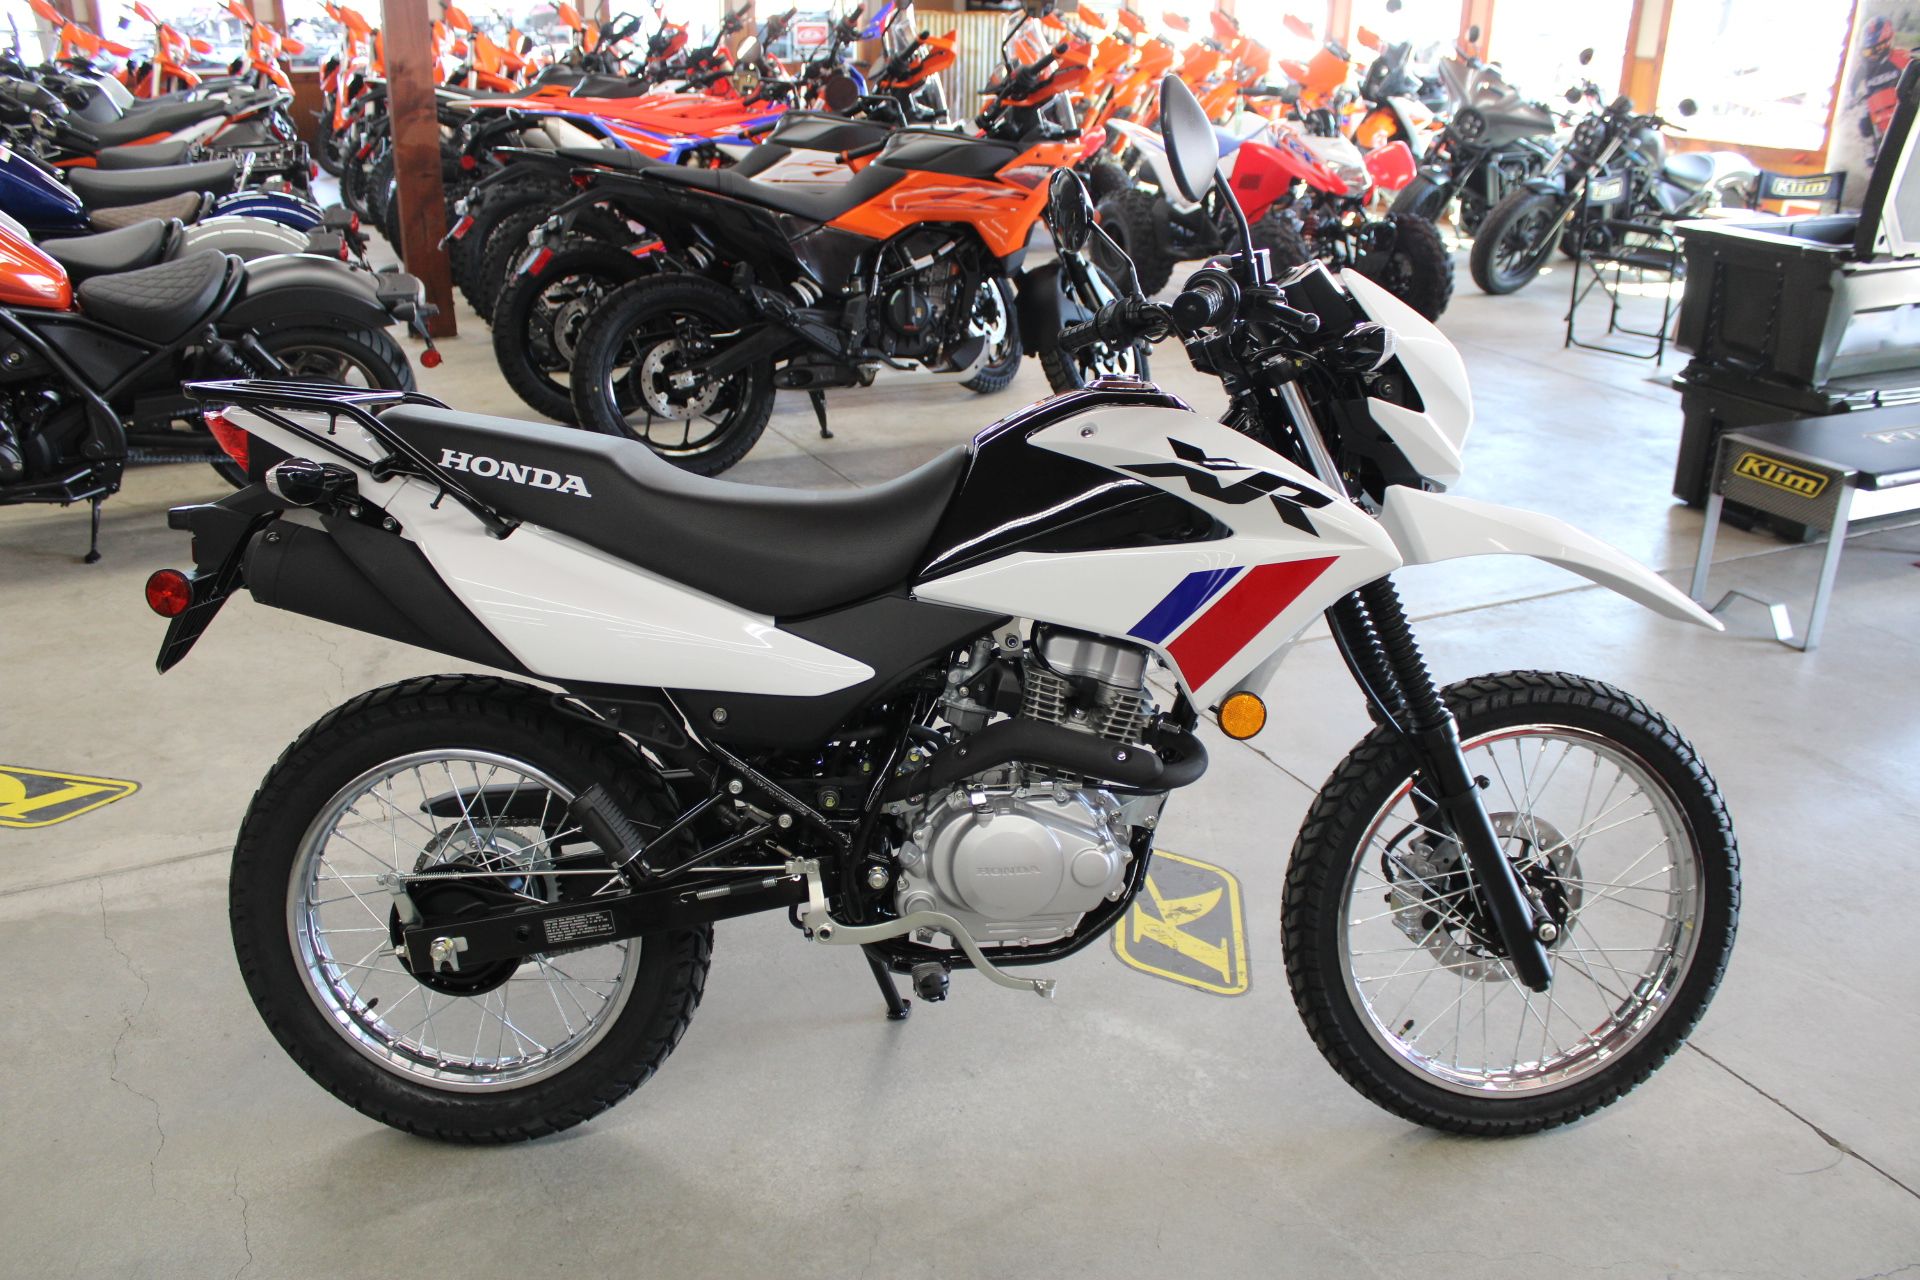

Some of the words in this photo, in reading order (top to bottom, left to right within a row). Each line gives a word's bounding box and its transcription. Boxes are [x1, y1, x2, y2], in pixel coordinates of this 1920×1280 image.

[1774, 180, 1826, 193] Klim
[438, 448, 592, 498] HONDA
[1741, 457, 1818, 493] Klim
[975, 865, 1041, 877] HONDA
